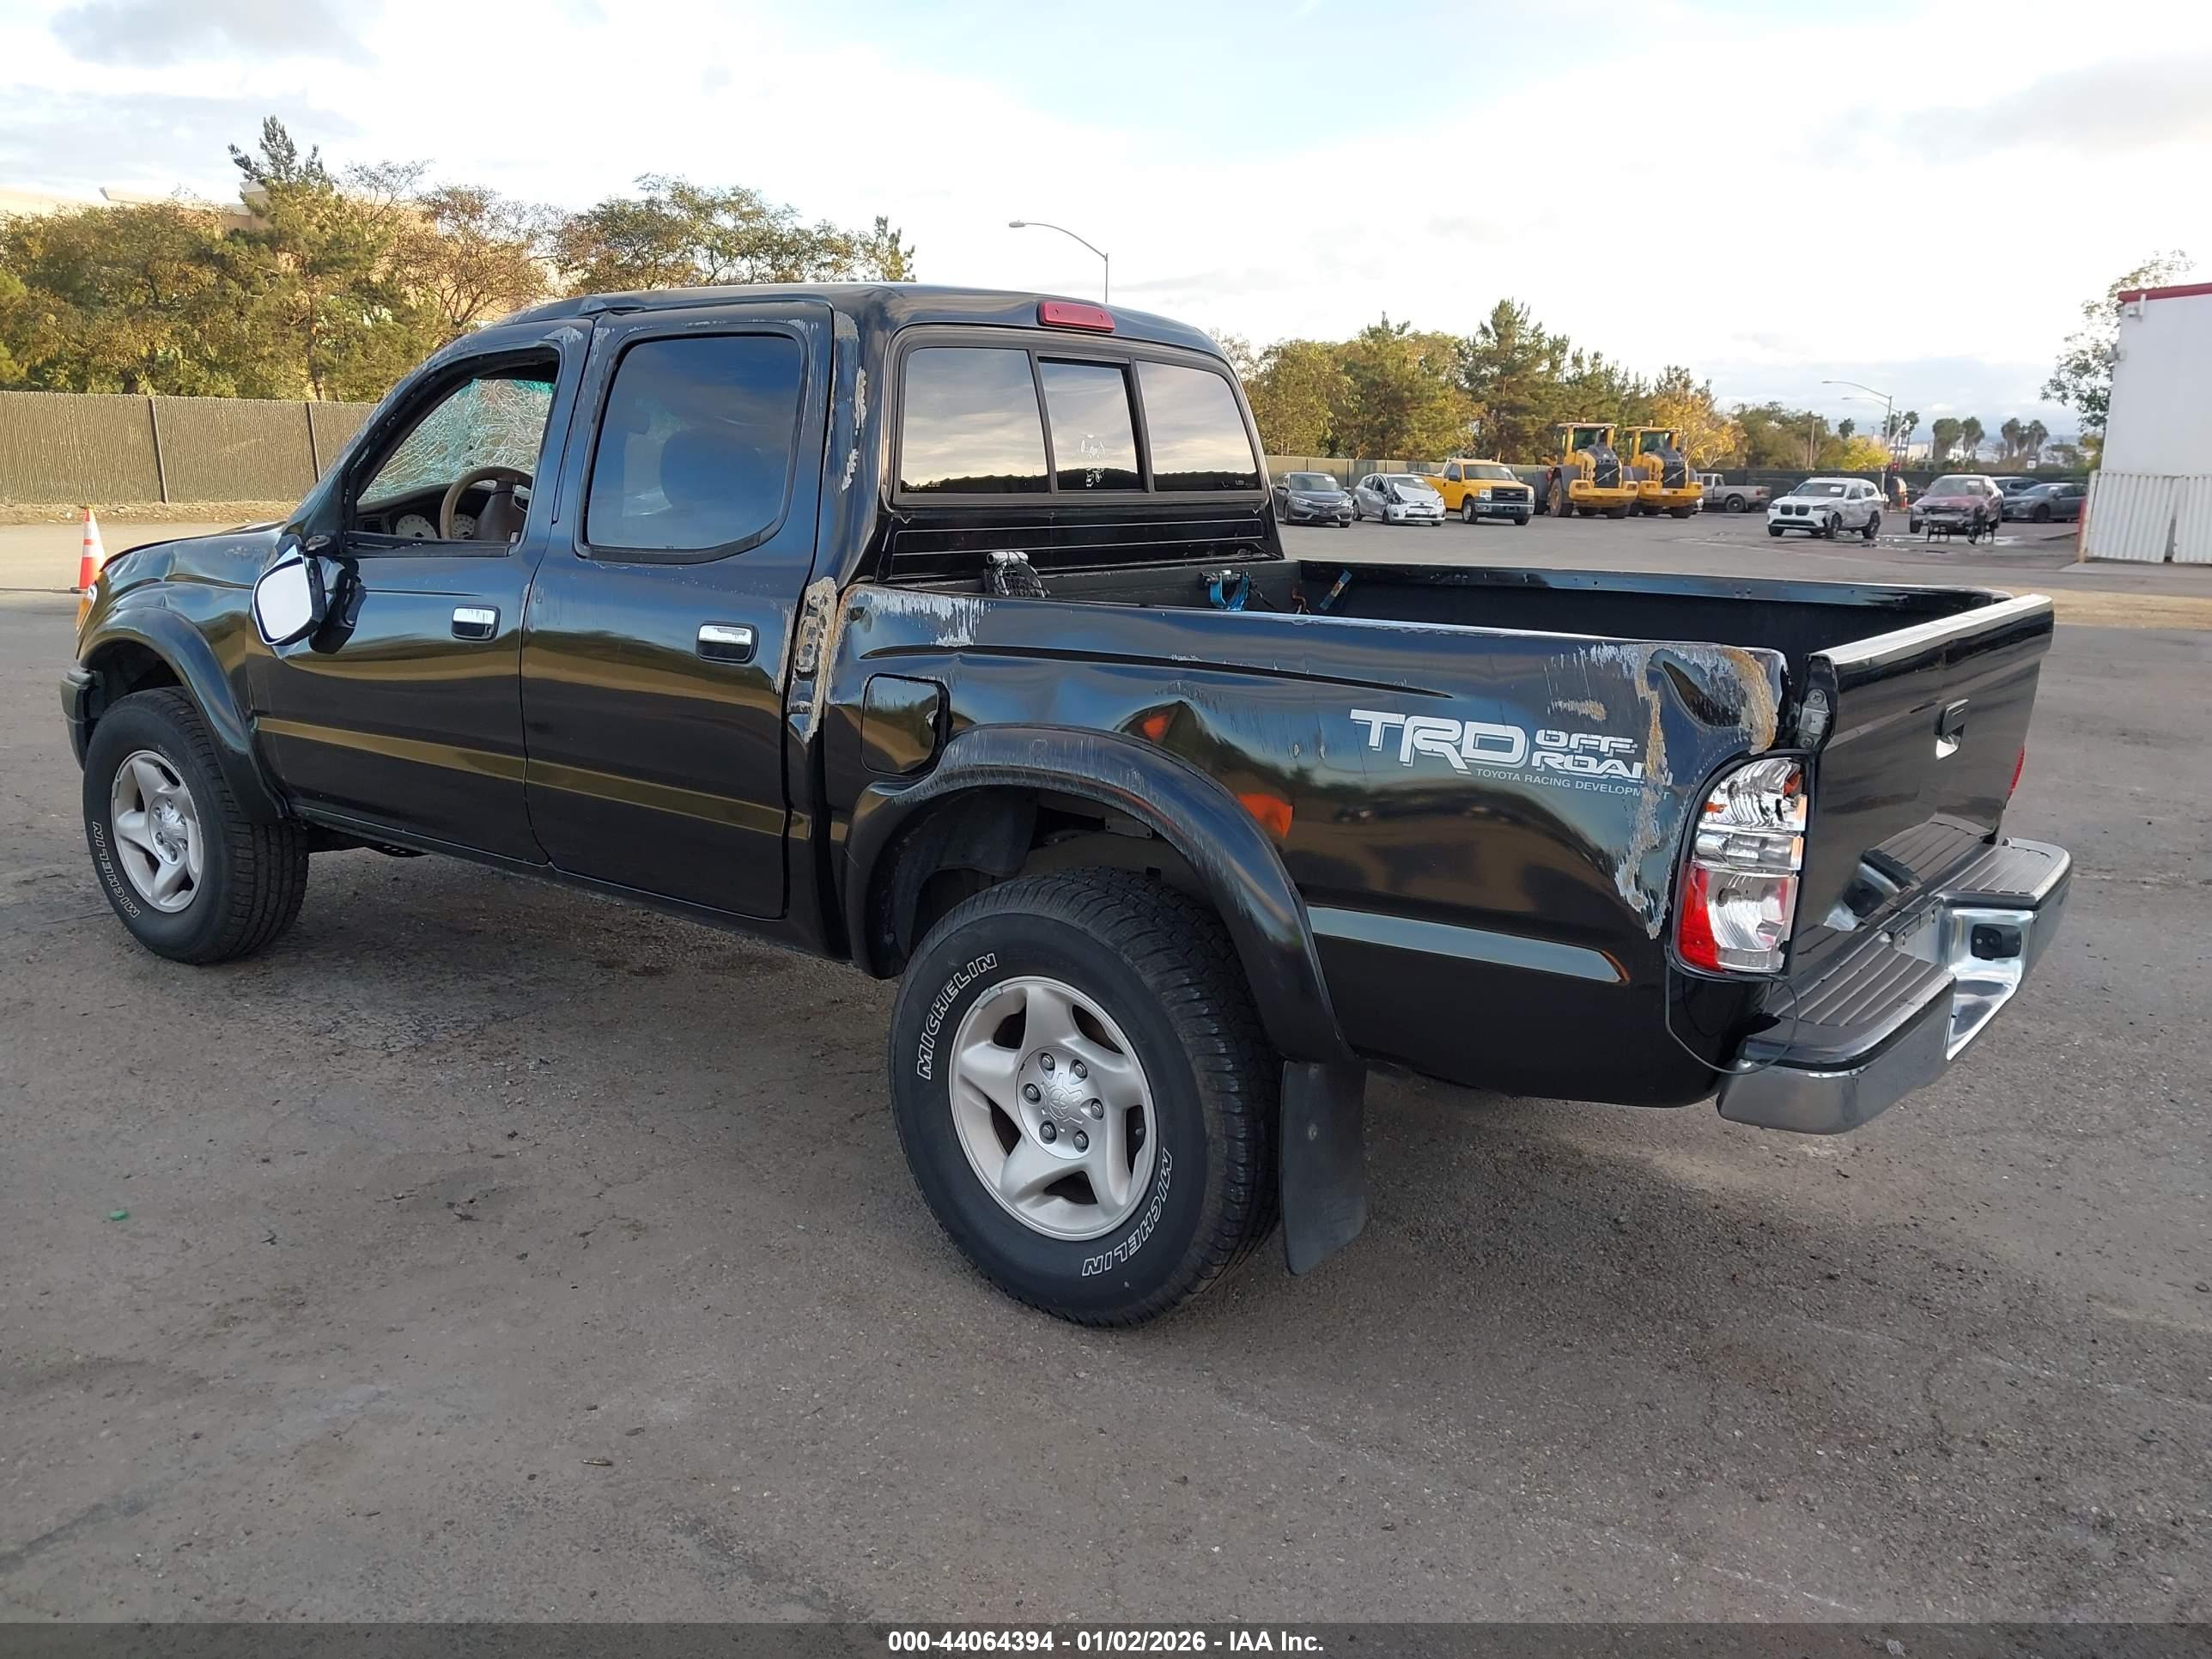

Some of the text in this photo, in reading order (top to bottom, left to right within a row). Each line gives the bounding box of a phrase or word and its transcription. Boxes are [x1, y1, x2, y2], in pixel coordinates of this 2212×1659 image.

[1350, 708, 1530, 775] TRD
[1476, 768, 1521, 783] TOYOTA
[1524, 775, 1571, 789] RACING
[1534, 729, 1638, 757] OFF
[93, 821, 140, 919] MICHELIN
[916, 953, 998, 1080] MICHELIN
[1081, 1147, 1173, 1277] MICHELIN
